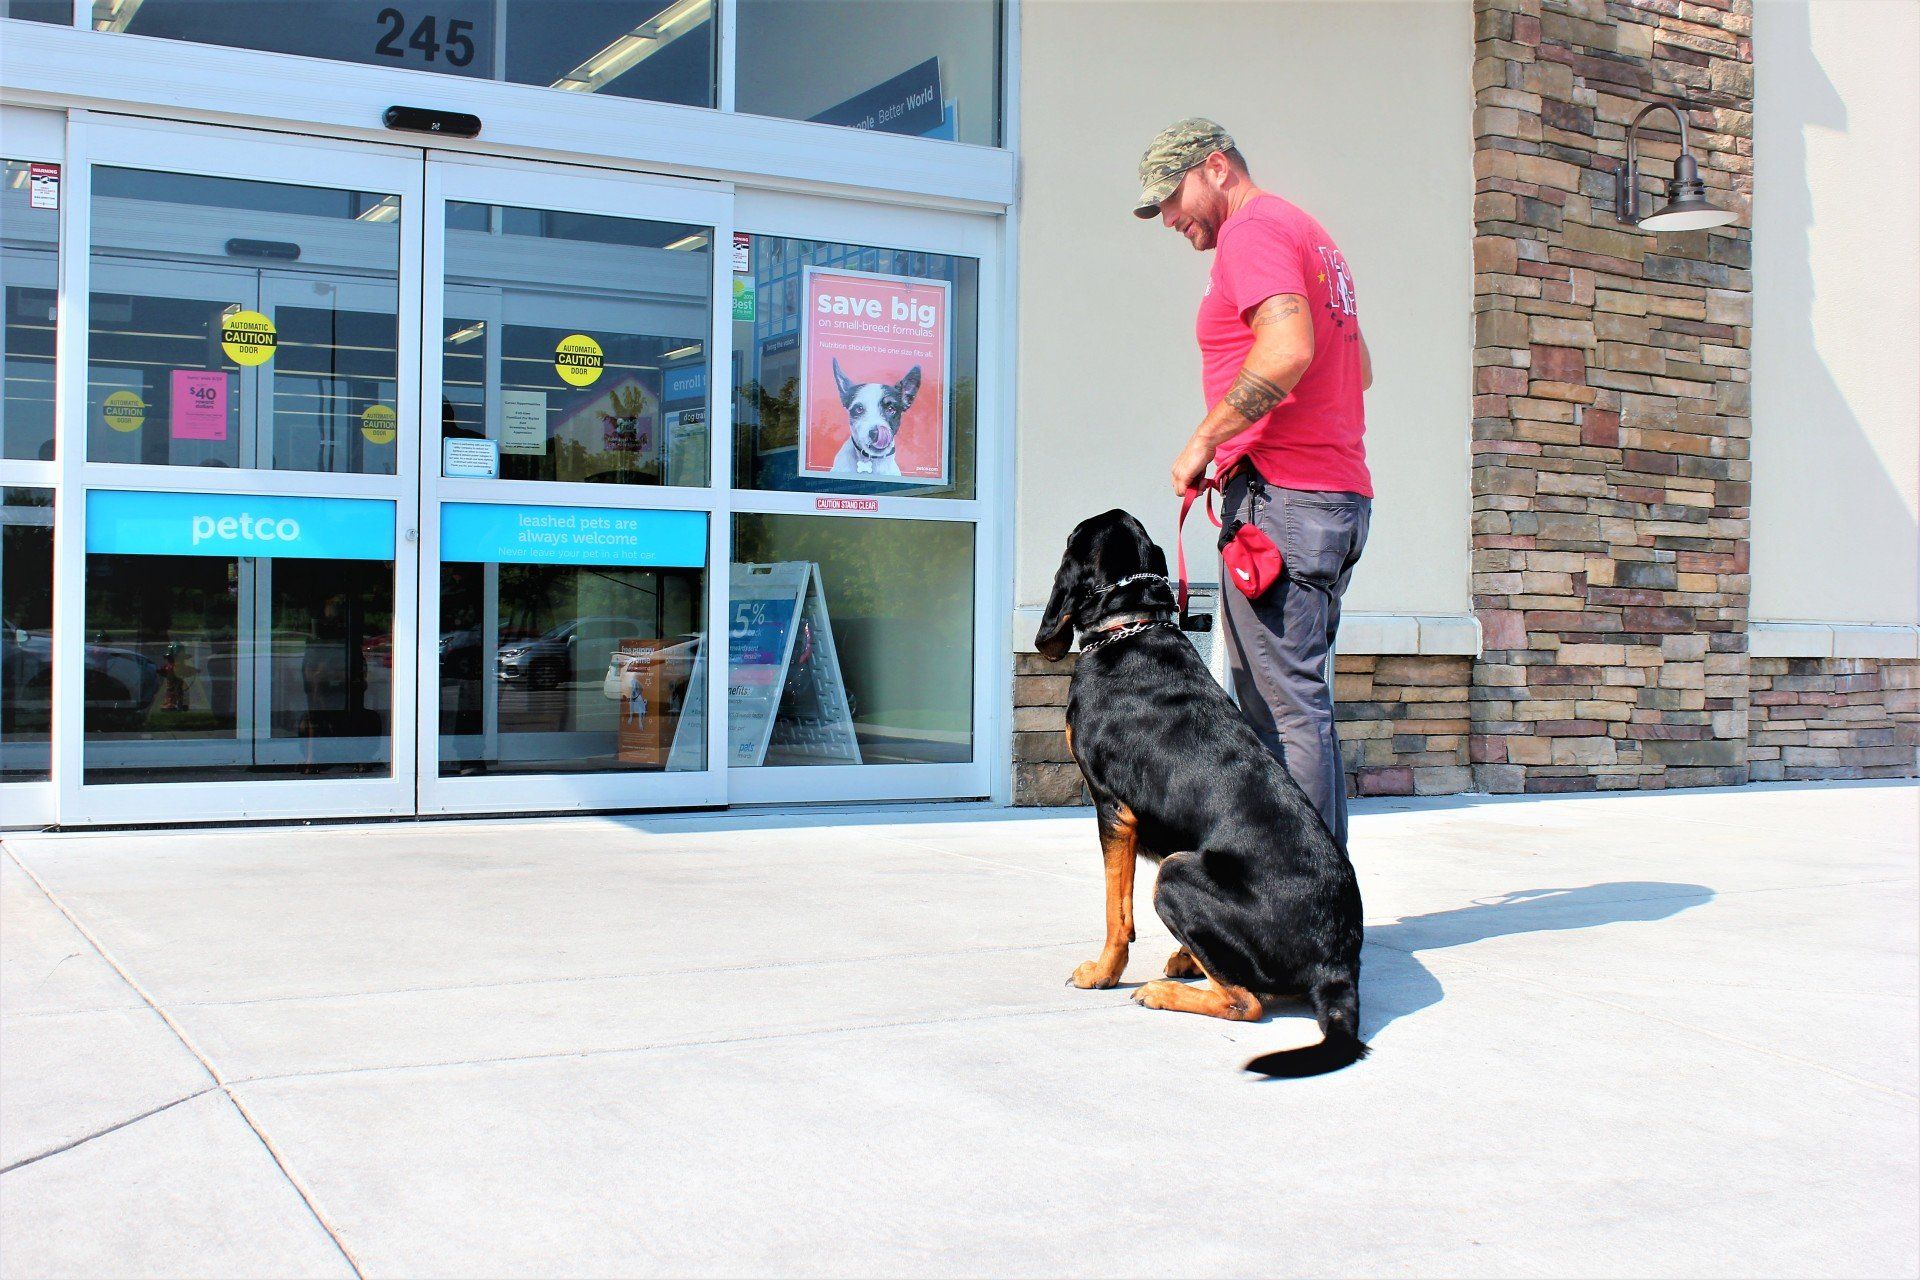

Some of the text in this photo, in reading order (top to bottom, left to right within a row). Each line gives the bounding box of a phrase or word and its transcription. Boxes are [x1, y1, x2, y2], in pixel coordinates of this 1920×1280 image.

[375, 8, 475, 67] 245
[846, 85, 934, 131] ople Better World
[32, 167, 58, 175] WARNING
[732, 299, 753, 310] Best
[817, 294, 936, 328] save big
[230, 321, 269, 331] AUTOMATIC
[818, 319, 935, 338] on small-breed formulas.
[225, 331, 273, 345] CAUTION
[239, 345, 259, 354] DOOR
[563, 344, 597, 354] AUTOMATIC
[819, 341, 847, 350] Nutrition
[848, 343, 877, 353] shouldn't
[877, 346, 887, 354] be
[900, 348, 912, 356] size
[913, 349, 924, 357] fits
[558, 353, 601, 367] CAUTION
[570, 367, 588, 375] DOOR
[673, 374, 701, 391] enroll
[190, 386, 217, 400] $40
[106, 406, 143, 416] CAUTION
[683, 412, 695, 423] dog
[363, 420, 396, 429] CAUTION
[817, 499, 877, 511] CAUTION STAND CLEAR
[192, 512, 300, 546] petco
[518, 514, 638, 531] leashed pets are
[518, 530, 638, 546] always welcome
[498, 547, 527, 556] Never
[530, 548, 555, 557] leave
[558, 550, 580, 559] your
[583, 550, 598, 559] pet
[600, 549, 610, 558] in
[622, 550, 638, 559] hot
[728, 684, 749, 696] nefits:
